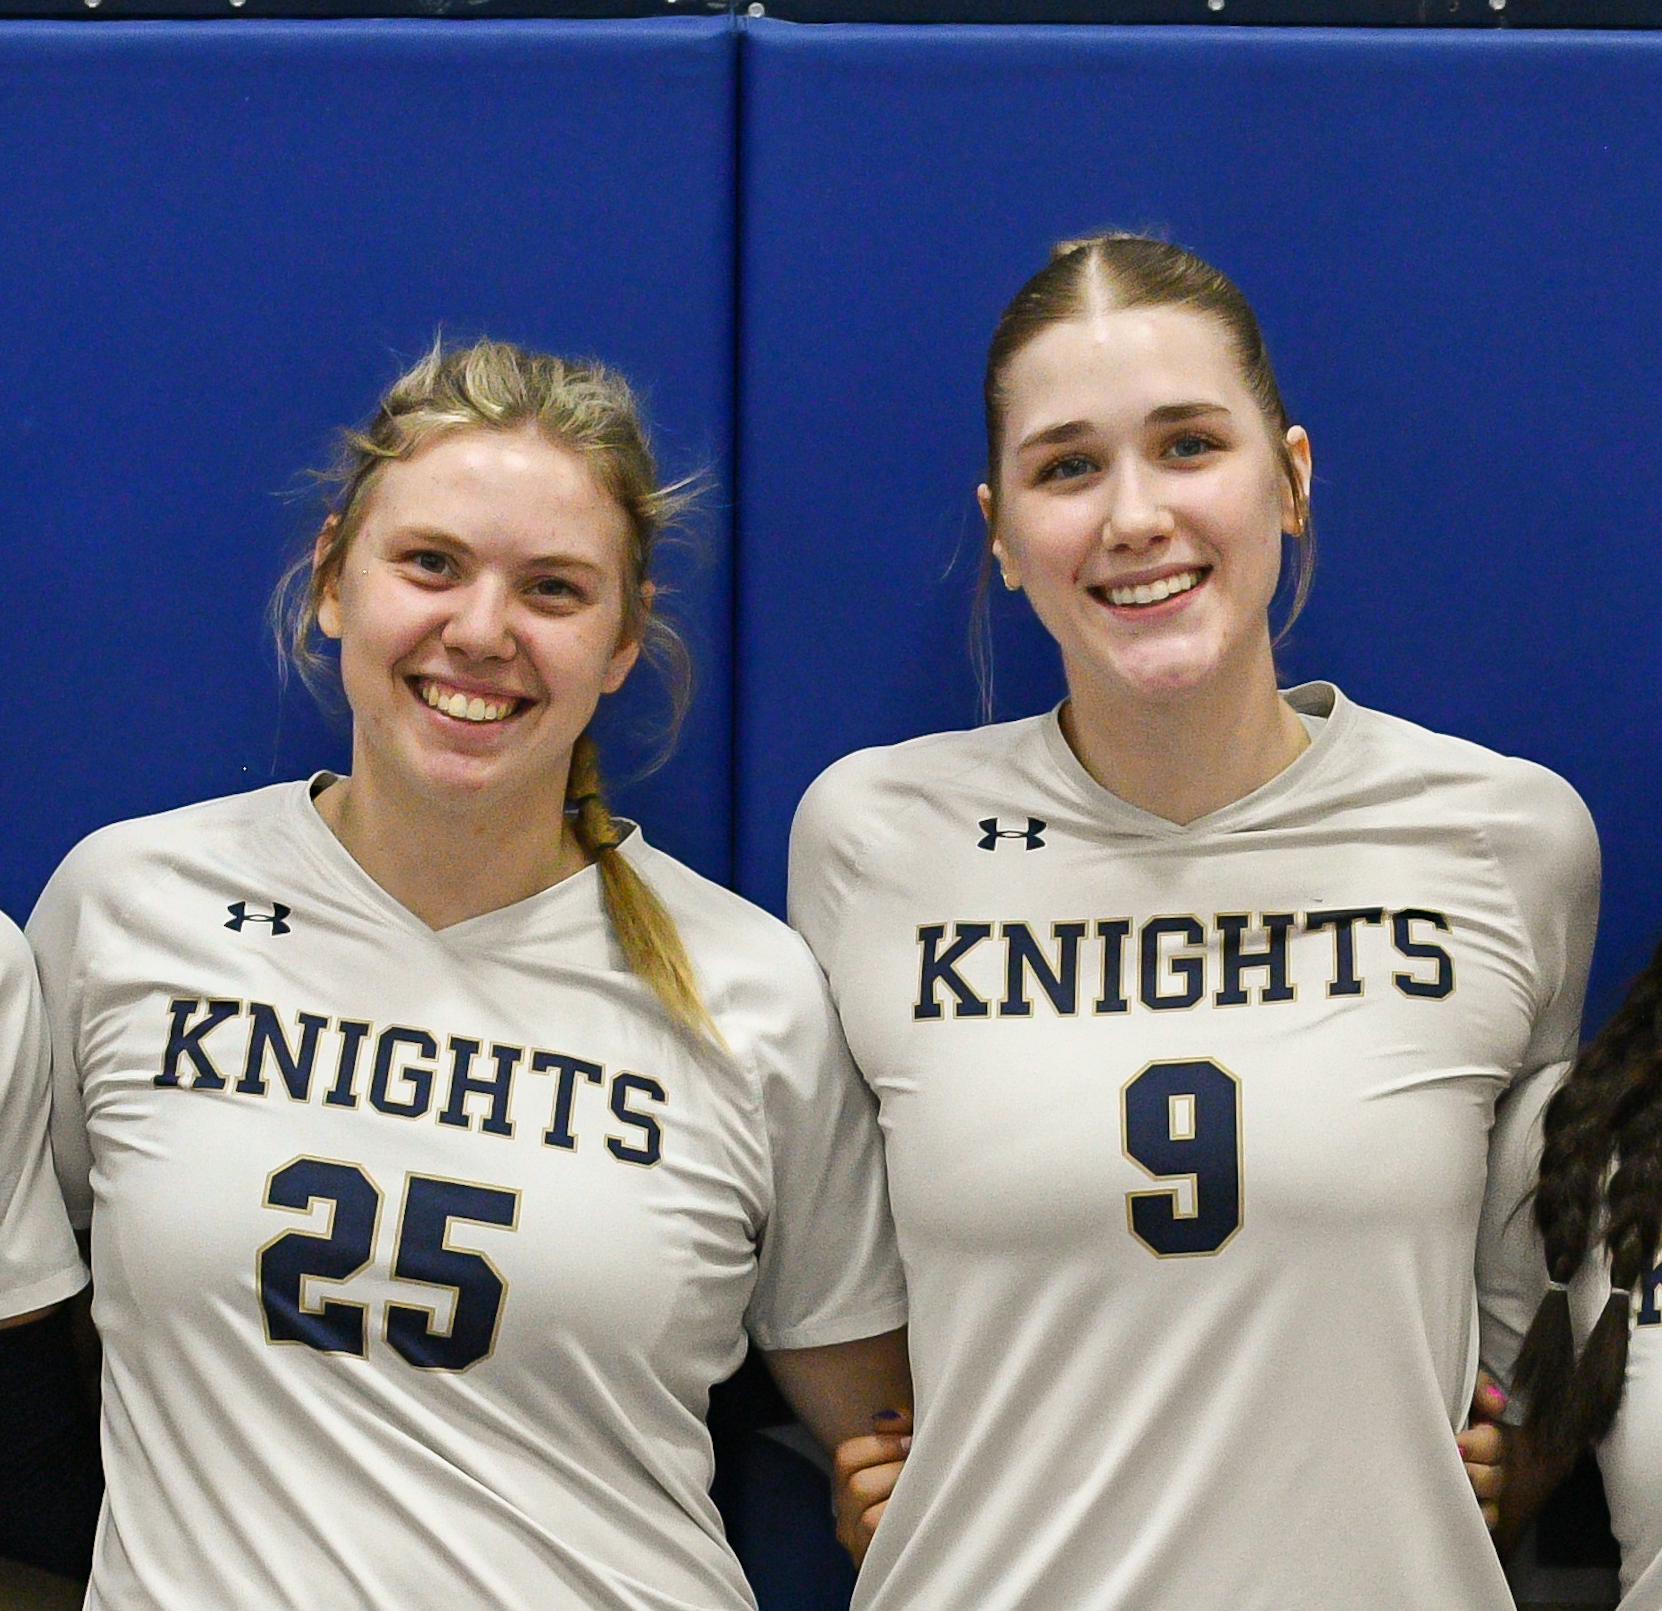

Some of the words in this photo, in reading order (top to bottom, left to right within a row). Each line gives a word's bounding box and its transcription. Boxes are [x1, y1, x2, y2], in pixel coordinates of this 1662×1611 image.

[911, 906, 1458, 1022] KNIGHTS
[152, 997, 669, 1169] KNIGHTS
[1119, 1055, 1245, 1260] 9
[255, 1153, 523, 1375] 25
